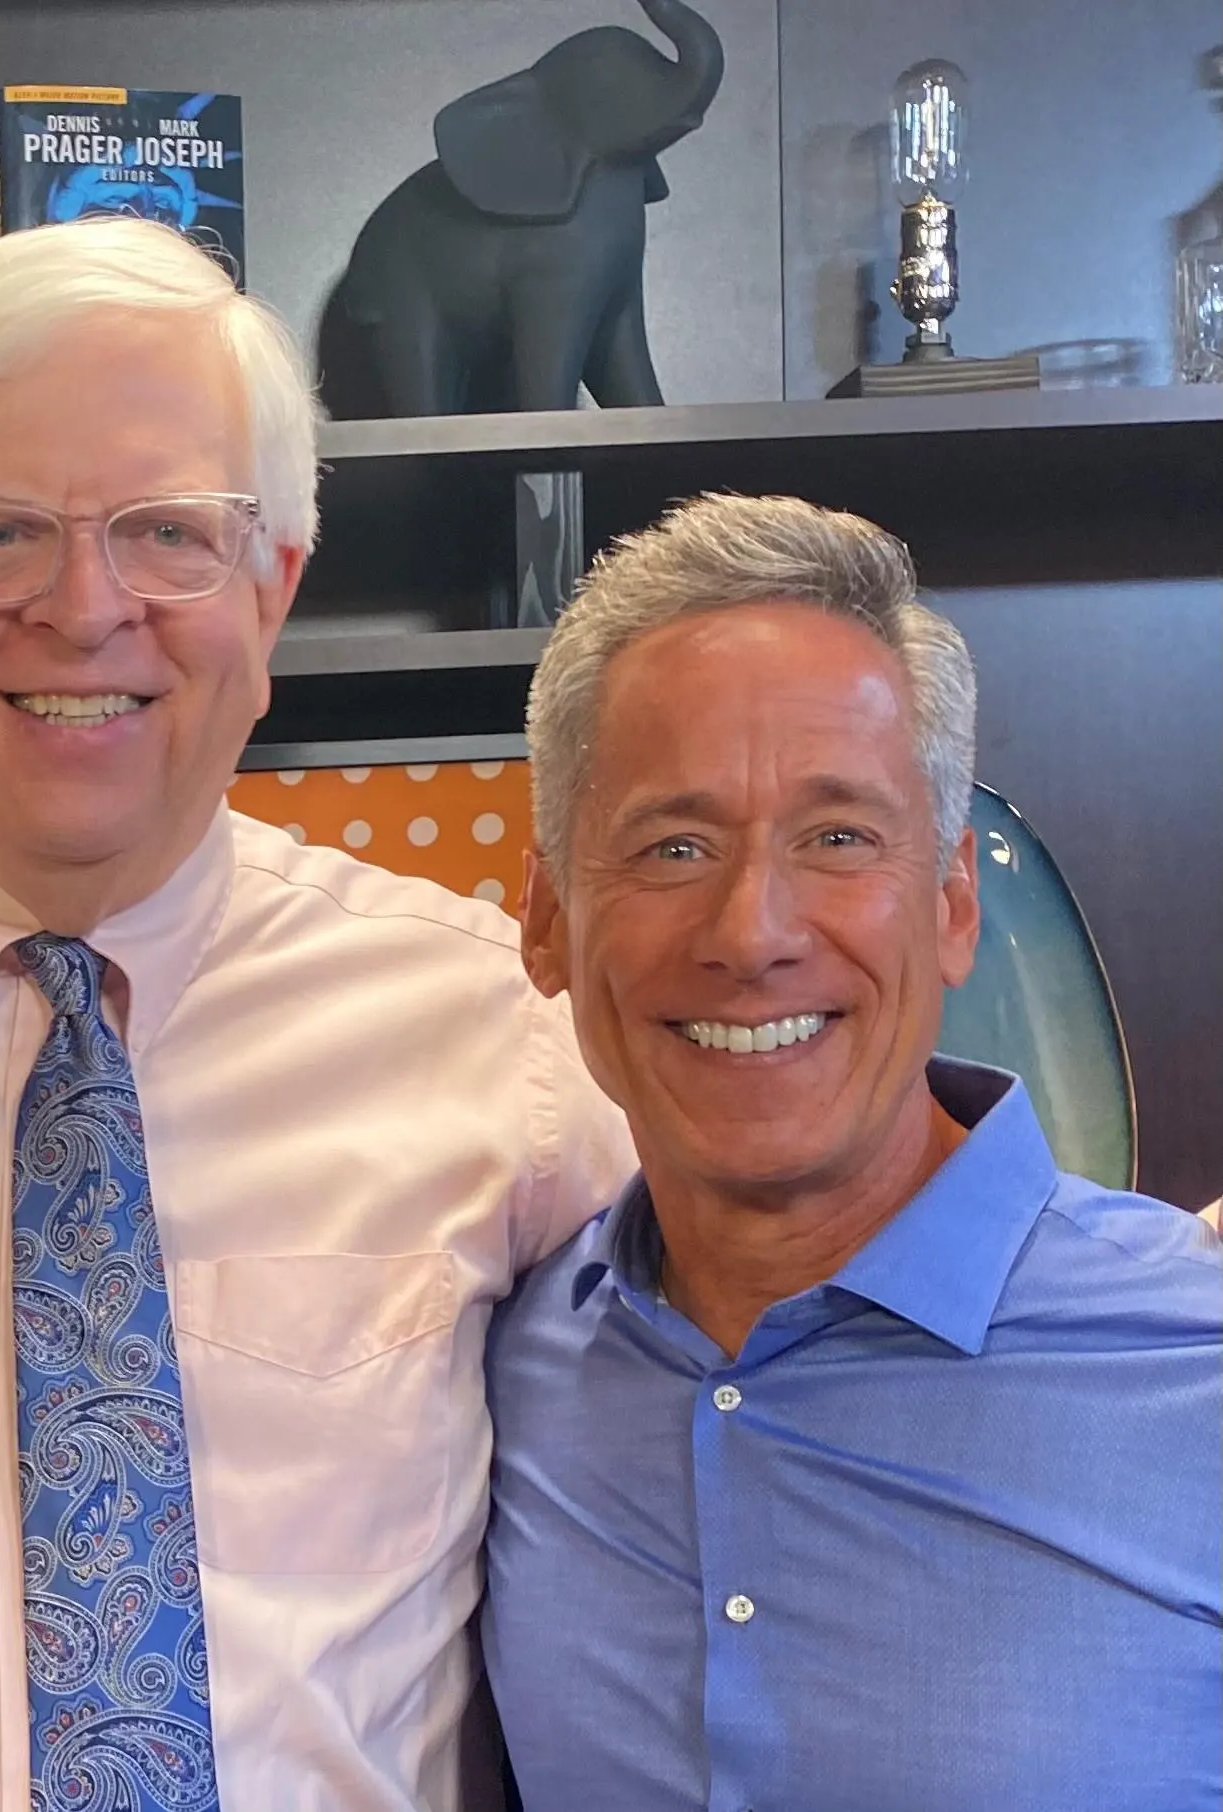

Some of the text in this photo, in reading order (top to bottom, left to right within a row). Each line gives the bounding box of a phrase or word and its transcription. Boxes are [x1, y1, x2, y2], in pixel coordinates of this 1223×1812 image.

[46, 114, 200, 138] DENNIS MARK
[23, 133, 225, 169] PRAGER JOSEPH
[101, 168, 155, 183] EDITORS
